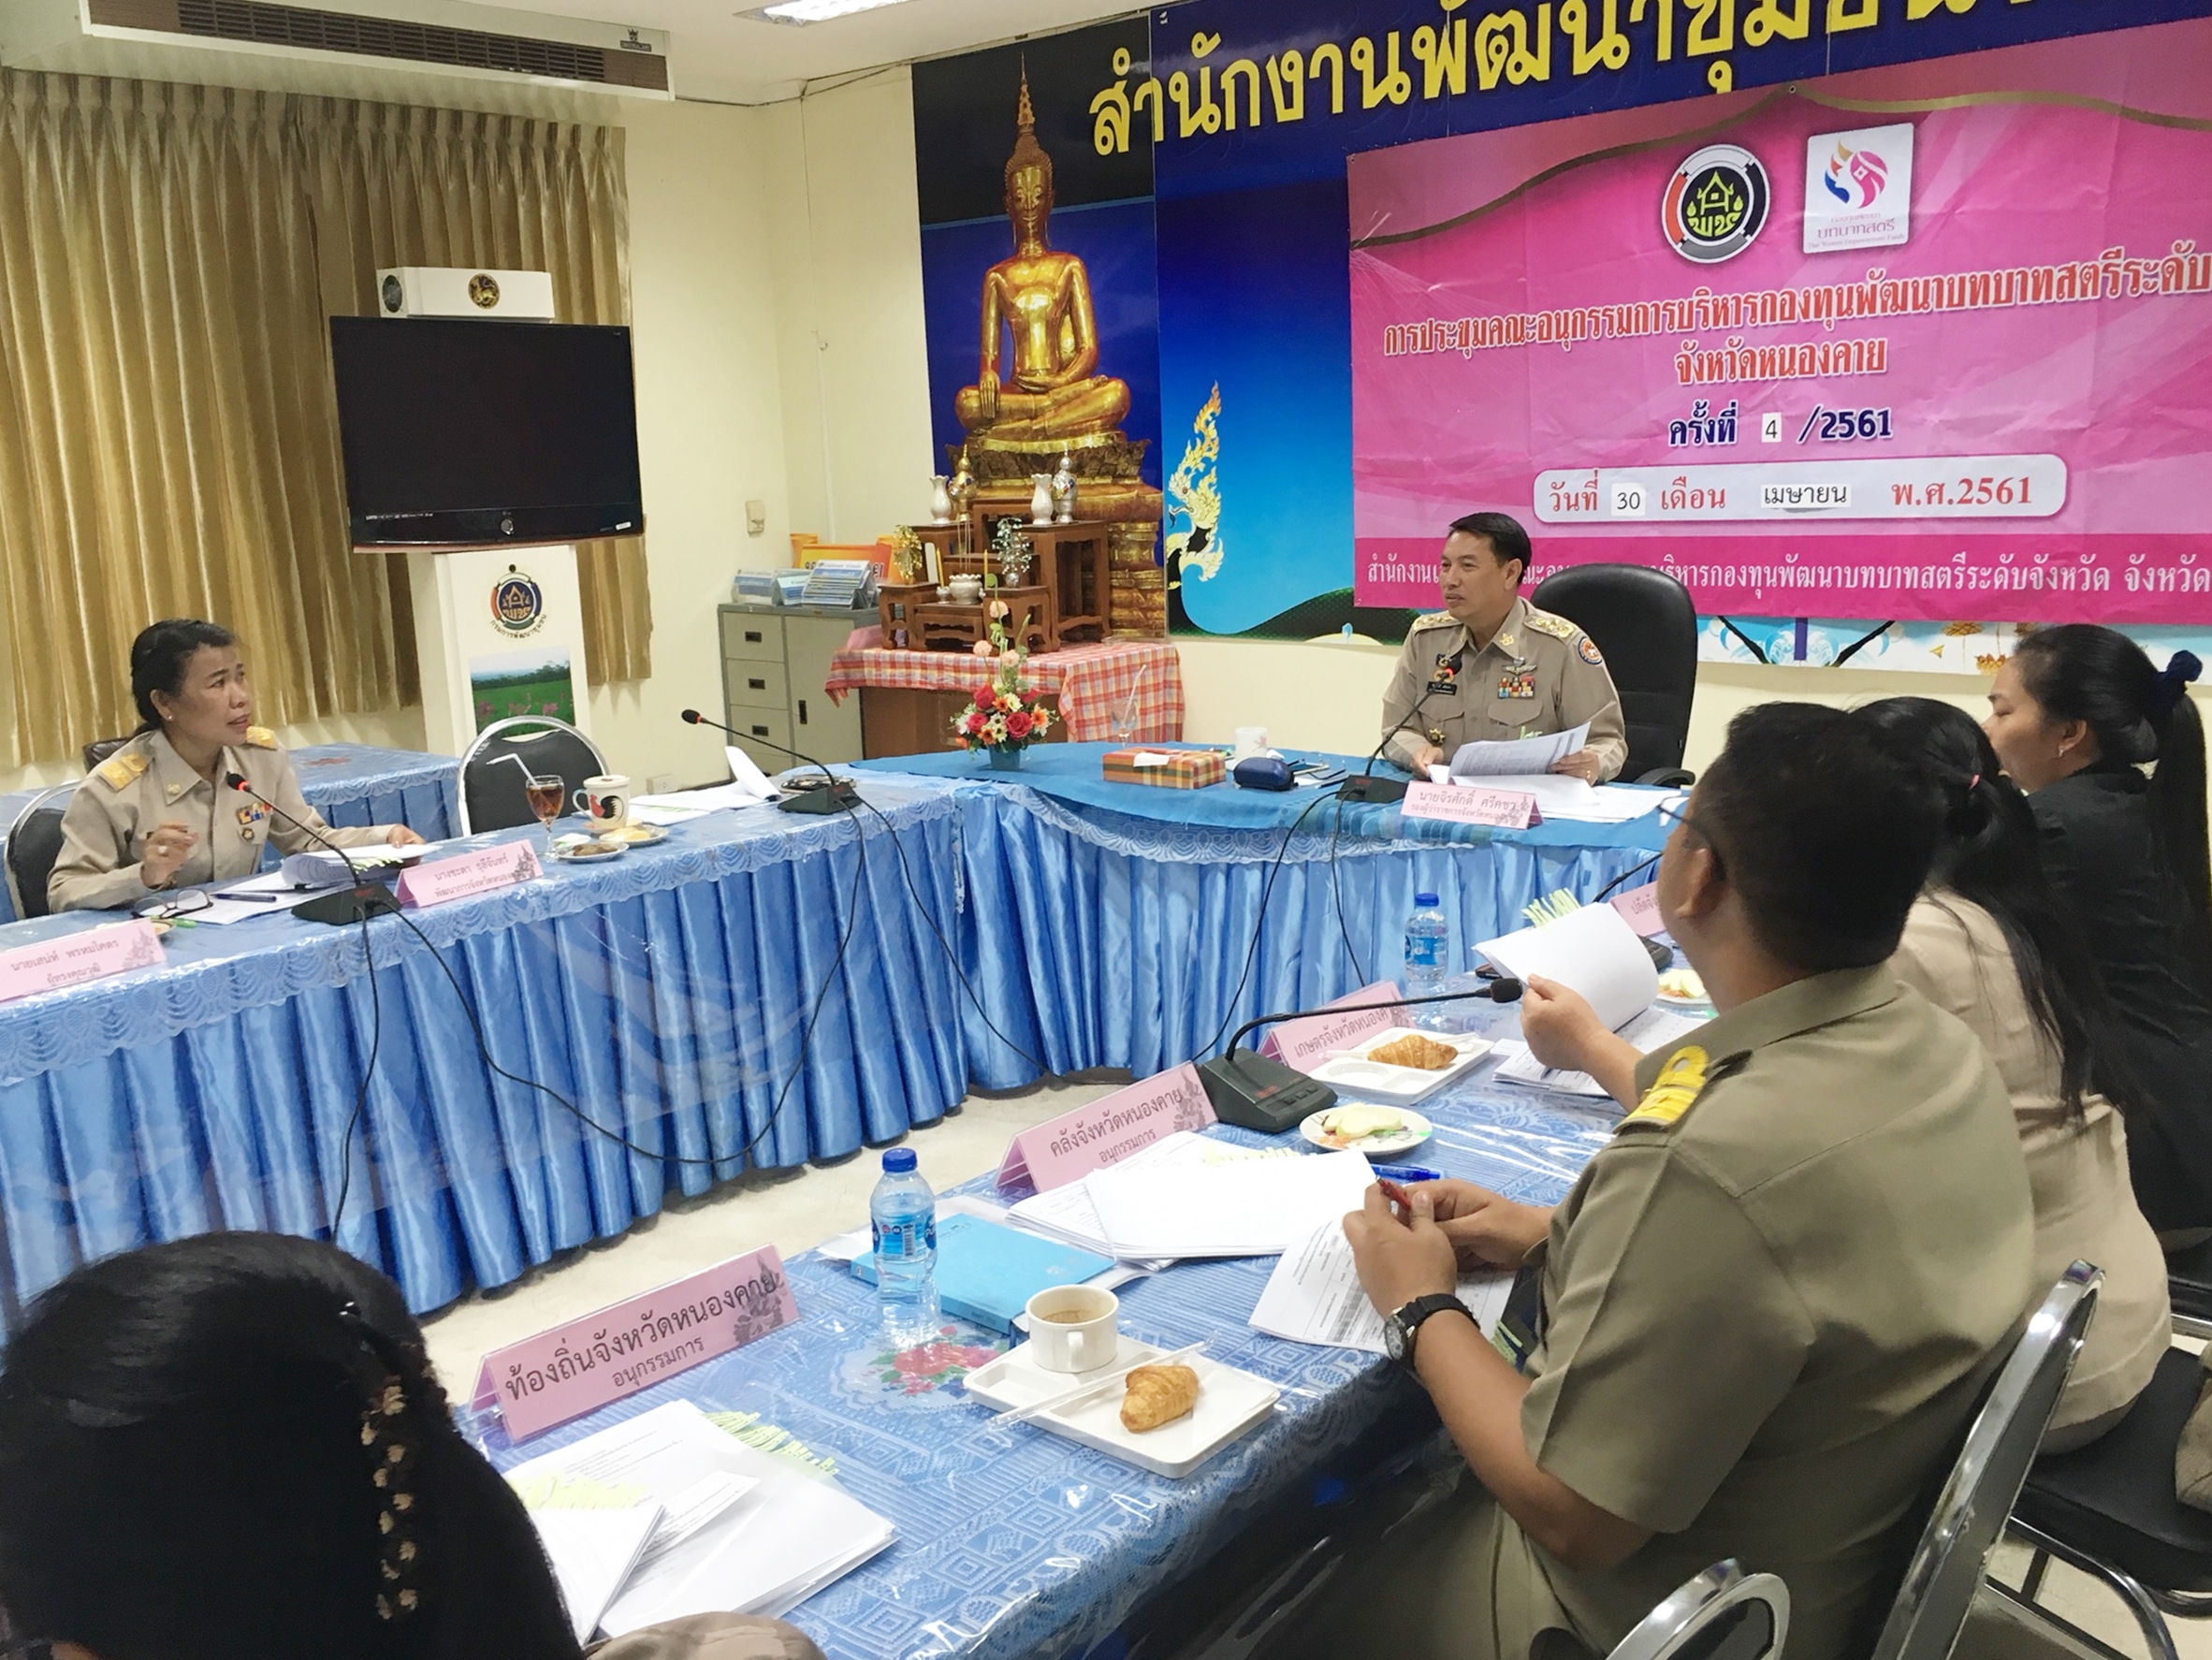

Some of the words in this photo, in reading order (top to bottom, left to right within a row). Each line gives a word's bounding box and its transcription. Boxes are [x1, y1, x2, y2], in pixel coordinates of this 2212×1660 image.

[1817, 217, 1896, 239] บทบาทสตรี
[1385, 240, 2211, 358] การประชุมคณะอนุกรรมการบริหารกองทุนพัฒนาบทบาทสตรีระดับ
[1674, 337, 1887, 385] จังหวัดหนองคาย
[1668, 400, 1738, 446] ครั้งที่
[1765, 420, 1779, 441] 4
[1797, 405, 1892, 443] /2561
[1550, 468, 1599, 512] วันที่
[1616, 491, 1641, 511] 30
[1661, 475, 1726, 510] เดือน
[1764, 483, 1847, 505] เมษายน
[1891, 475, 2033, 507] พ.ศ.2561
[2124, 553, 2210, 592] จังหวัด
[1049, 1086, 1183, 1158] คลังจังหวัดหนองคาย
[1099, 1128, 1157, 1163] อนุกรรมการ
[505, 1272, 777, 1401] ท้องถิ่นจังหวัดหนองคาย
[612, 1336, 705, 1387] อนุกรรมการ
